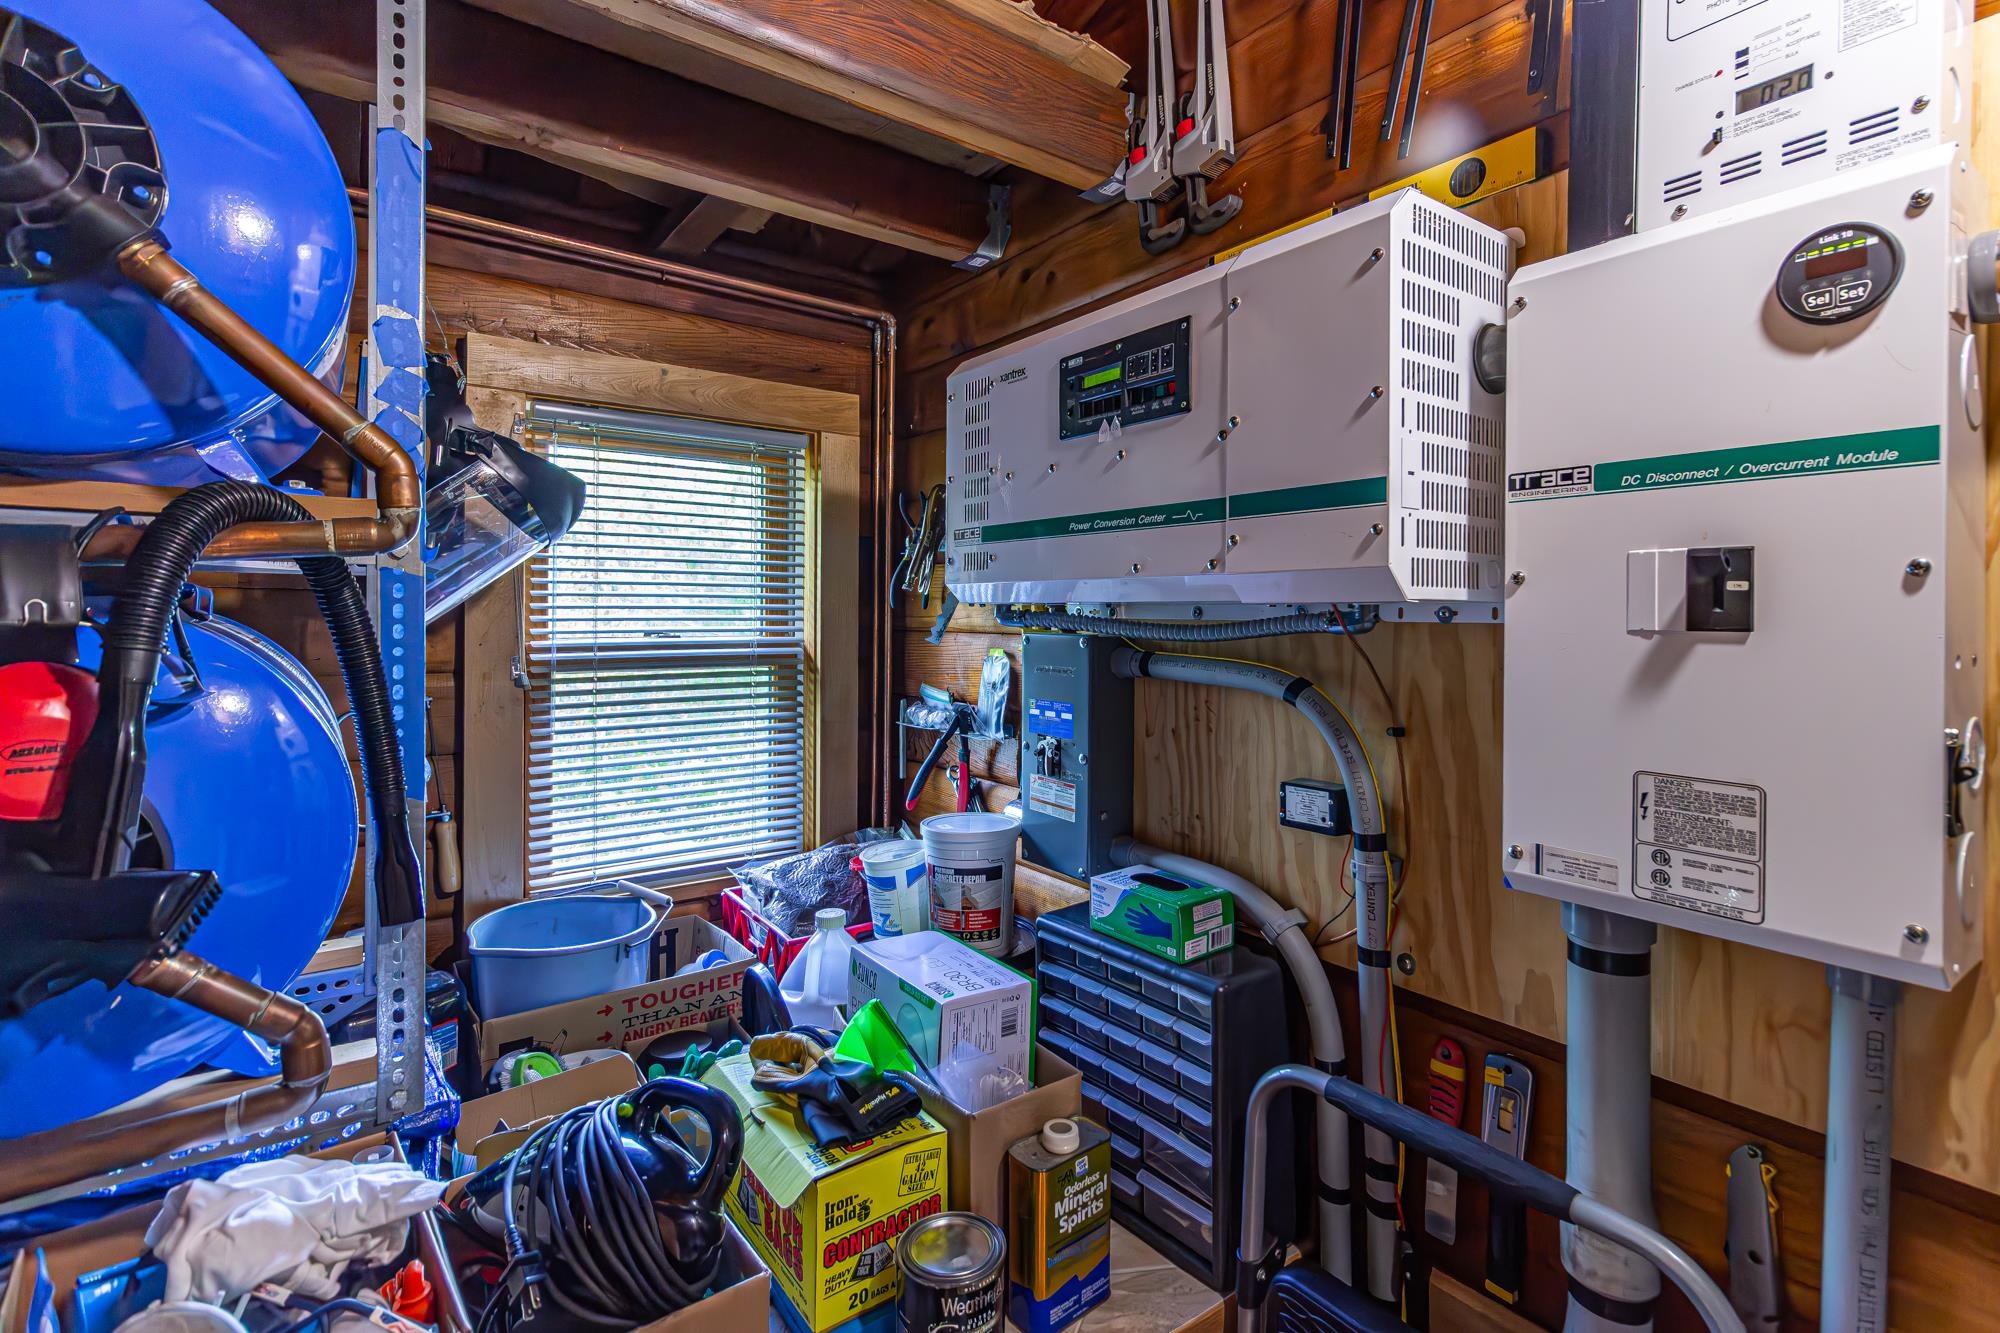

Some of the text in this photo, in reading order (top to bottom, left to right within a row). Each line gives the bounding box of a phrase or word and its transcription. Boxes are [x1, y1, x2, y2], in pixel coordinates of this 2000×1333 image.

[1819, 233, 1840, 244] Link
[1807, 286, 1865, 307] Sel Set
[1000, 367, 1026, 383] xantrex
[1621, 474, 1640, 486] DC
[1646, 466, 1720, 484] Disconnect
[1739, 457, 1830, 475] Overcurrent
[1837, 447, 1900, 466] Module
[1510, 485, 1589, 498] ENGINEERING
[1069, 513, 1166, 532] Power Conversion Center
[1654, 777, 1694, 789] DANGER:
[935, 873, 987, 884] CONCRETE REPAIR
[1367, 885, 1377, 922] CANTEX
[857, 963, 878, 991] SUNCO
[622, 998, 702, 1029] THAN
[622, 1018, 676, 1045] ANGRY
[1866, 1030, 1885, 1095] LISTED
[905, 1150, 940, 1165] EXTRA LARGE
[915, 1160, 927, 1173] 42
[902, 1169, 936, 1186] GALLON
[907, 1180, 927, 1192] SIZE!
[1064, 1171, 1100, 1197] Odorless
[825, 1194, 859, 1218] Iron-
[1055, 1174, 1107, 1219] Mineral
[825, 1205, 857, 1232] Hold
[1059, 1198, 1104, 1234] Spirits
[823, 1192, 942, 1270] CONTRACTOR
[824, 1266, 853, 1287] HEAVY
[824, 1278, 848, 1296] DUTY
[849, 1287, 869, 1311] 20
[871, 1284, 889, 1299] BAGS
